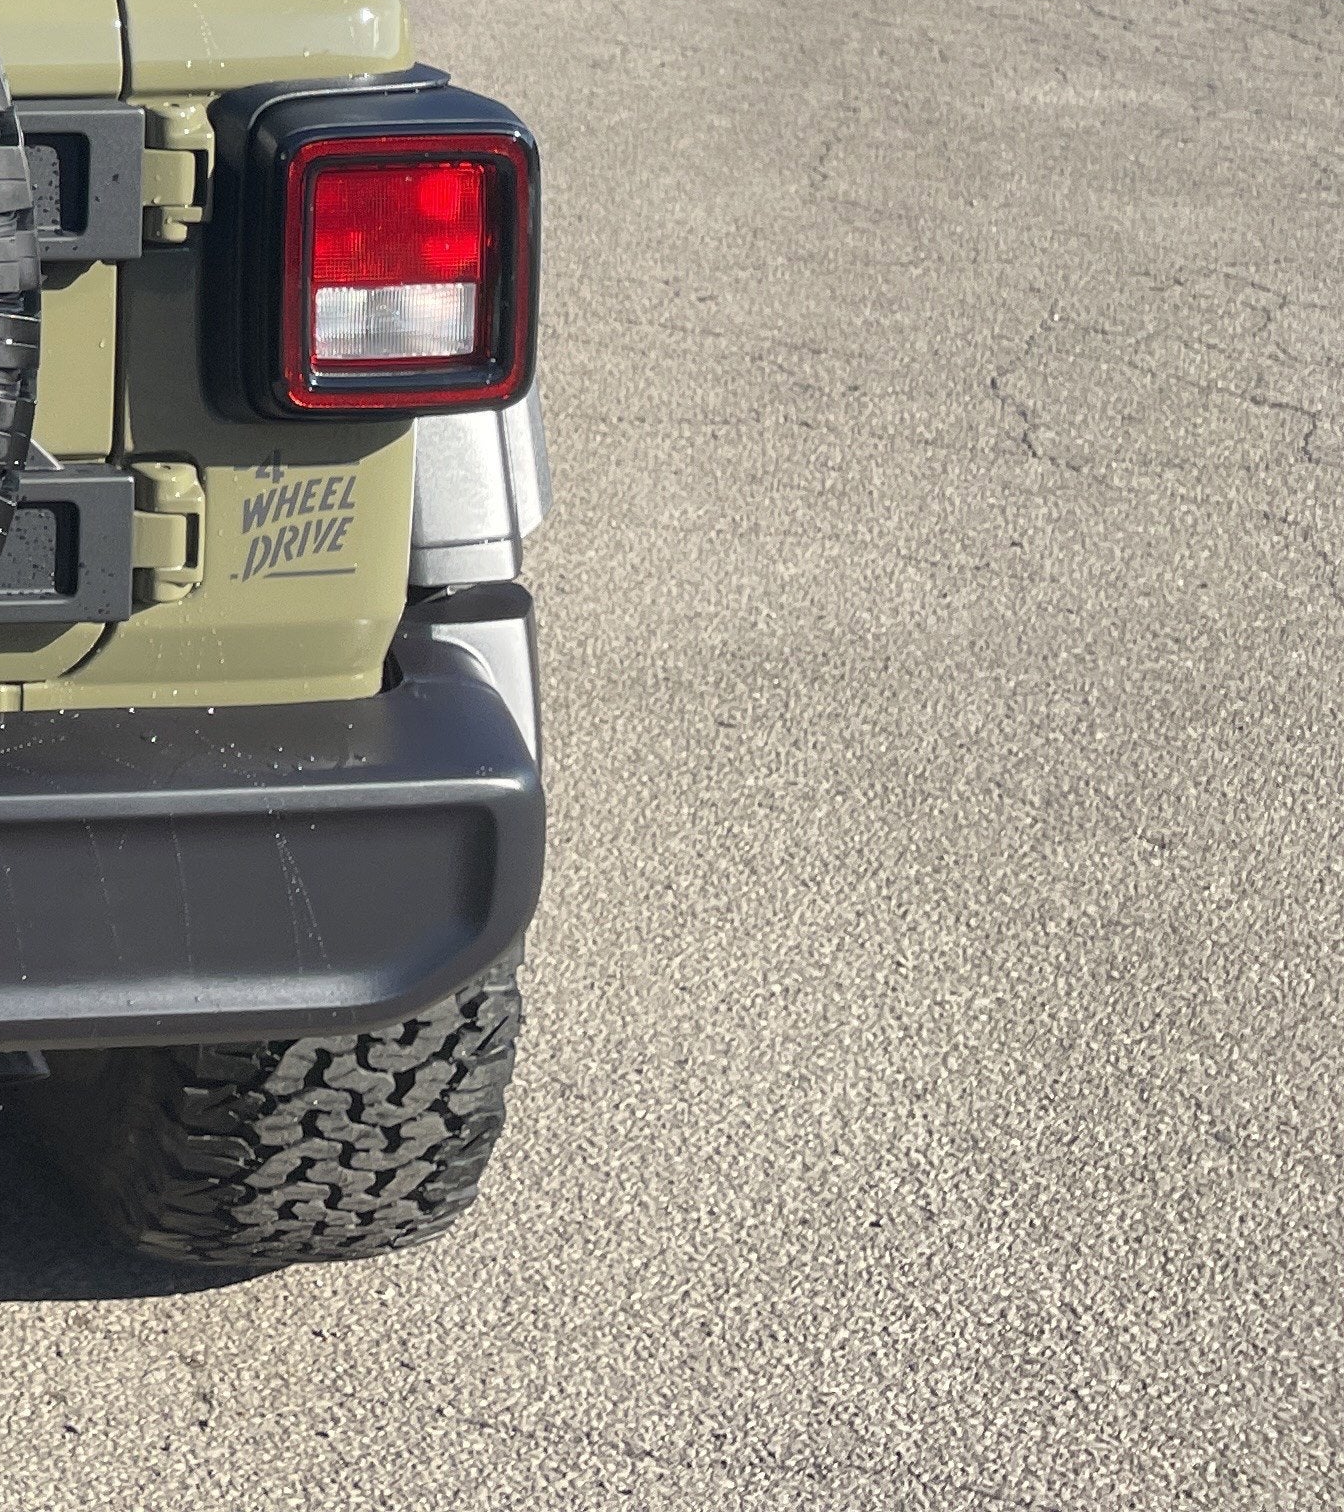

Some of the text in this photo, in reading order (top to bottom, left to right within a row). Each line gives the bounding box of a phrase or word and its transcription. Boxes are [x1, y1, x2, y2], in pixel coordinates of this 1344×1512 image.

[255, 449, 285, 484] 4
[242, 475, 357, 535] WHEEL
[242, 517, 355, 583] DRIVE
